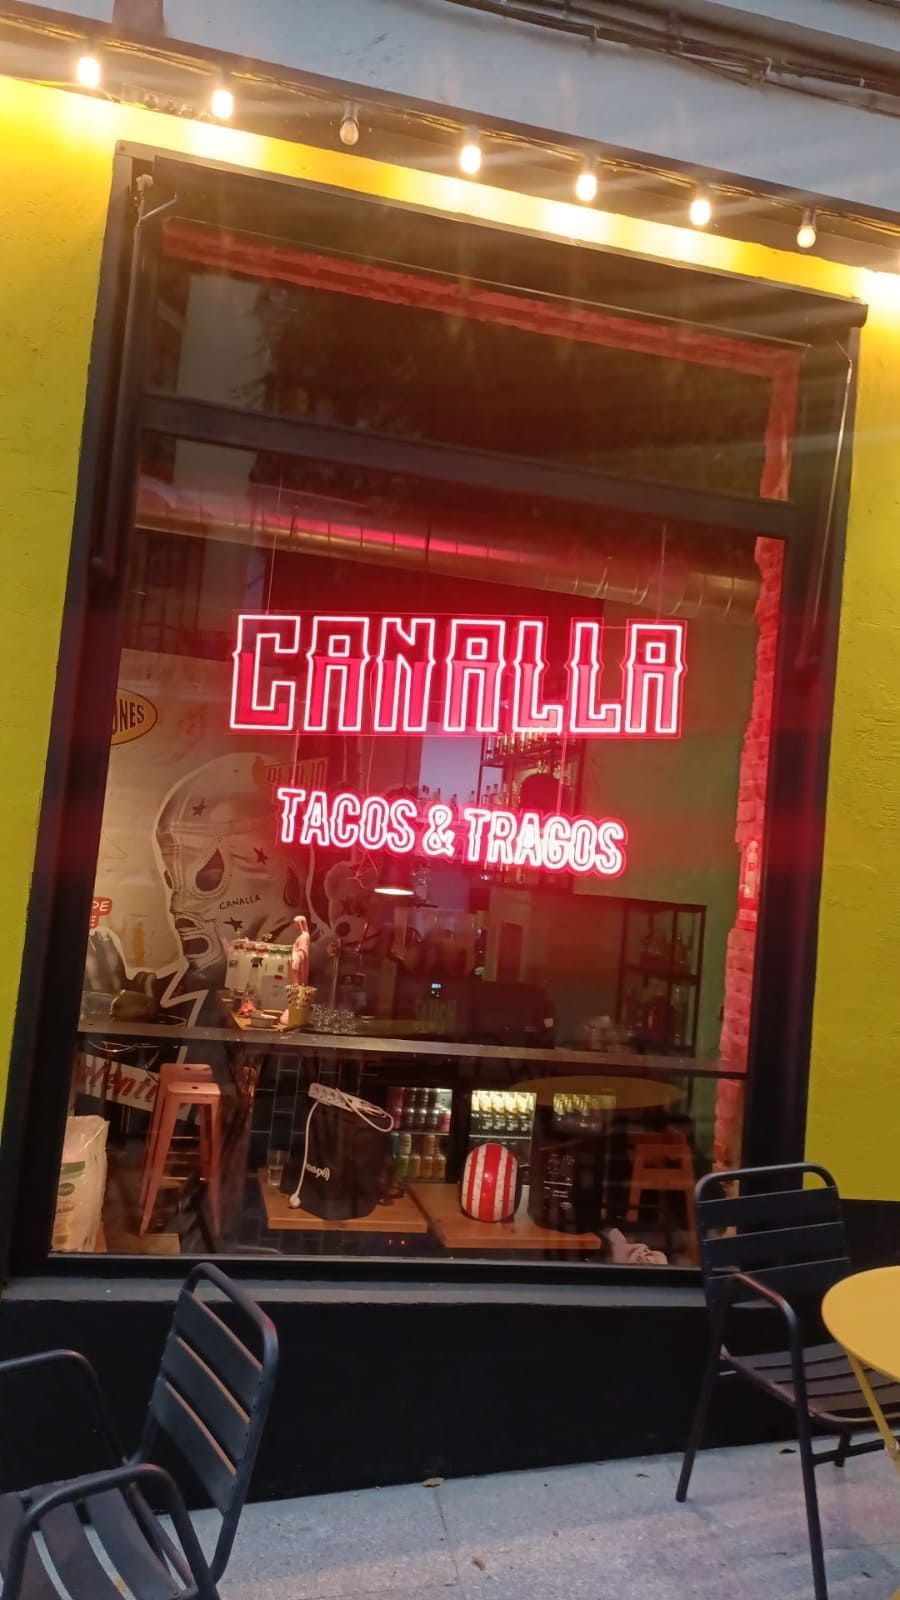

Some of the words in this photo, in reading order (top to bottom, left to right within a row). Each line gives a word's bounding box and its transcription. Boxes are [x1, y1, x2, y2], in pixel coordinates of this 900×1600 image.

[229, 614, 686, 734] CANALLA
[277, 787, 417, 853] TACOS
[422, 804, 456, 858] &
[464, 807, 625, 875] TRAGOS
[219, 894, 262, 910] CANALLA
